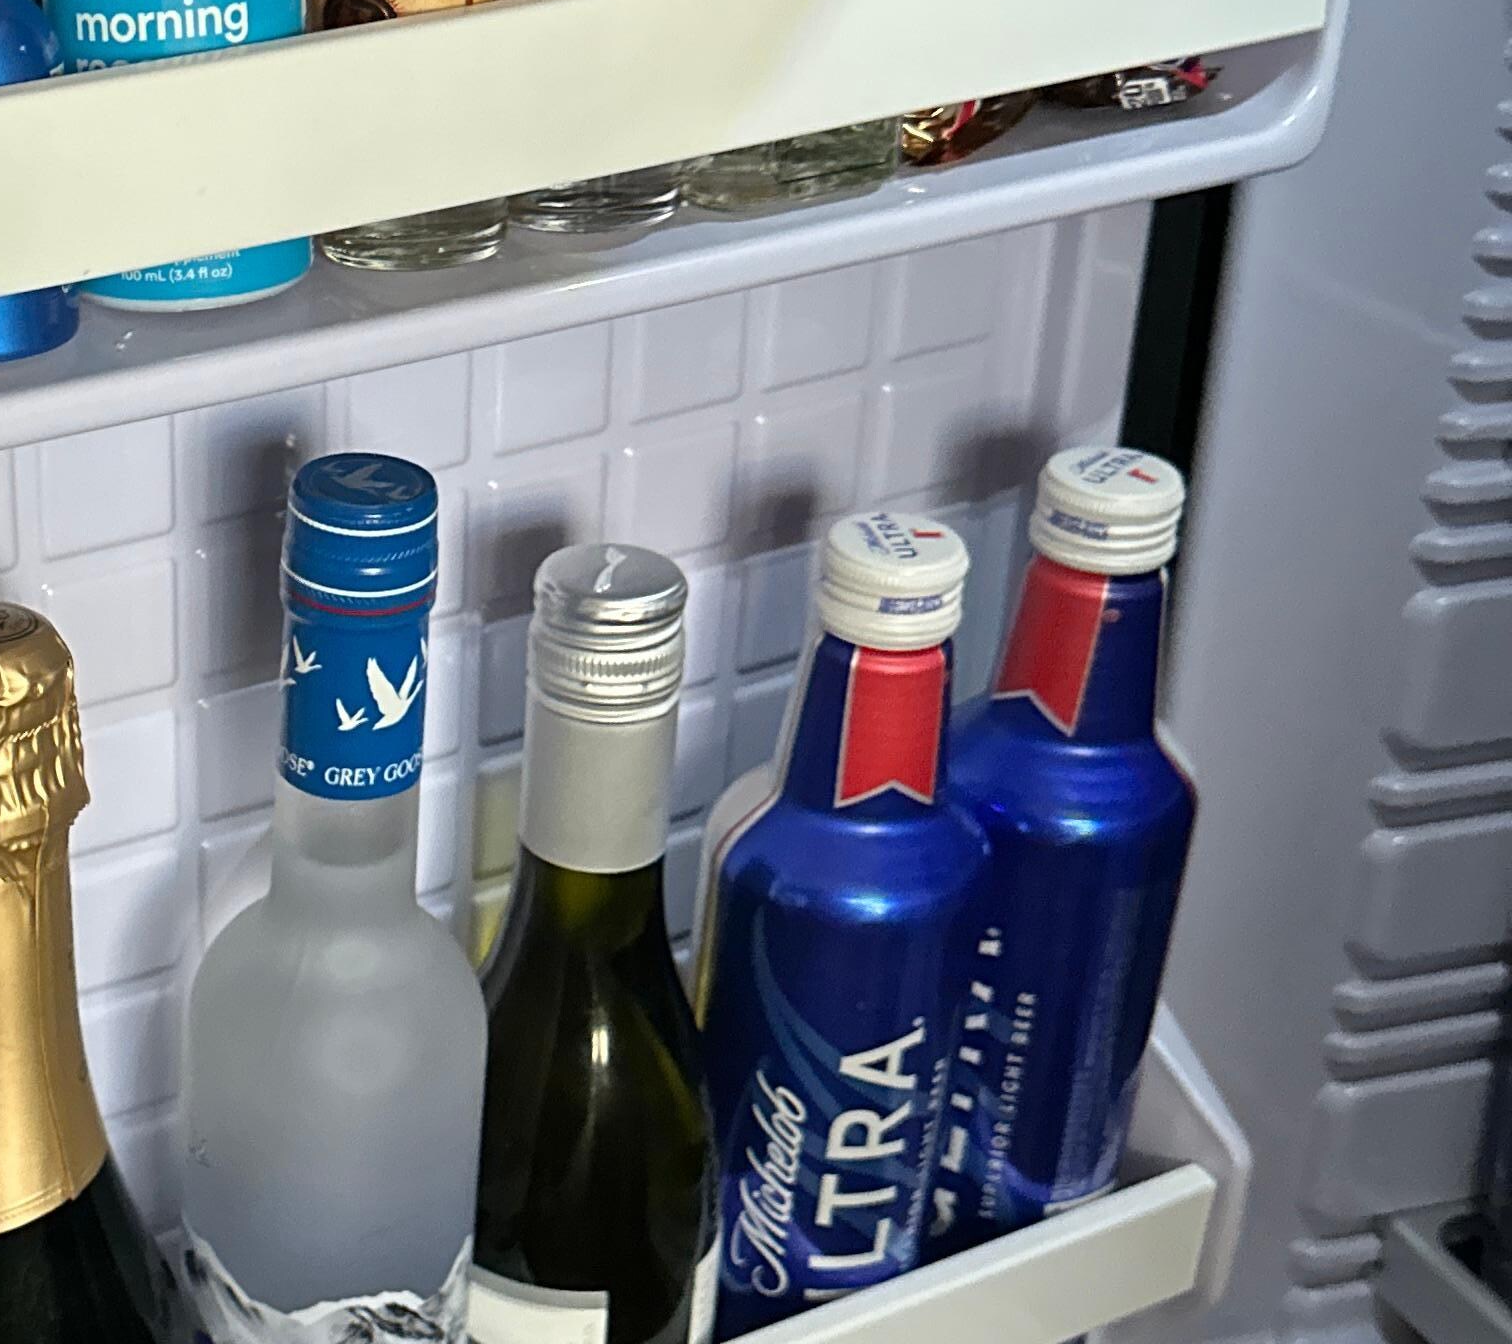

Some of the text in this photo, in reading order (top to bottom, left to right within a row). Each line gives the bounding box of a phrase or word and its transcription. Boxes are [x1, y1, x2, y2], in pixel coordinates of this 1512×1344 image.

[144, 268, 166, 282] mL
[169, 265, 195, 284] (3.4
[197, 265, 209, 280] fl
[211, 263, 233, 281] oz)
[324, 766, 381, 787] GREY
[730, 1068, 808, 1299] Michelob
